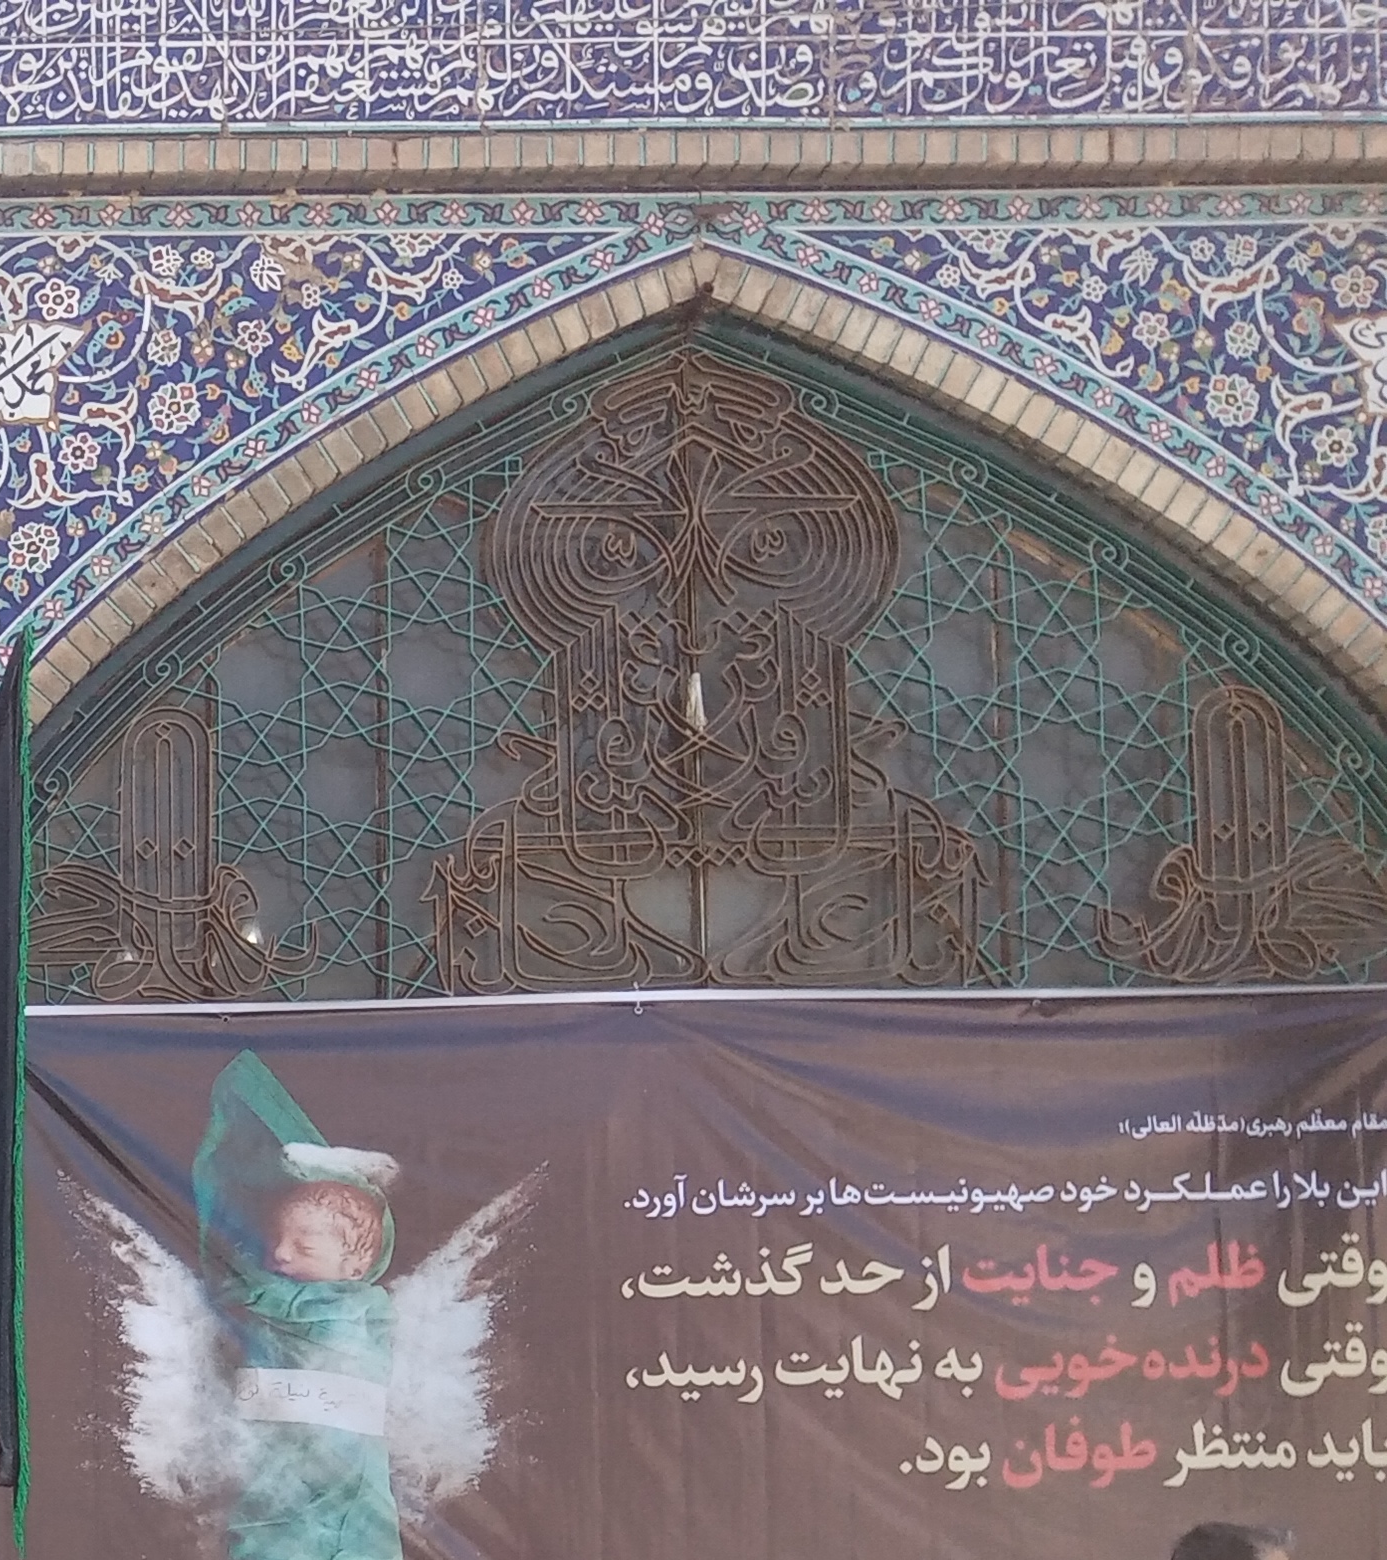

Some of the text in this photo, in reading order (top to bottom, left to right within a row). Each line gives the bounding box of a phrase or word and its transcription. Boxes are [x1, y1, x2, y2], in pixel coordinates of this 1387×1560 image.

[691, 1179, 796, 1217] سرشان
[798, 1189, 825, 1216] بر
[1060, 1175, 1118, 1212] خود
[1124, 1171, 1268, 1212] عملکرد
[1272, 1170, 1291, 1209] را
[1294, 1170, 1330, 1207] بلا
[1336, 1169, 1387, 1209] این
[819, 1259, 904, 1296] حد
[911, 1243, 951, 1310] از
[962, 1244, 1119, 1306] جنایت
[1131, 1262, 1157, 1308] و
[1168, 1239, 1266, 1308] ظلم
[1277, 1232, 1387, 1307] وقتی
[775, 1335, 922, 1400] نهایت
[933, 1346, 984, 1398] به
[1280, 1321, 1387, 1397] وقتی
[1002, 1416, 1157, 1490] طوفان
[1162, 1418, 1297, 1488] منتظر
